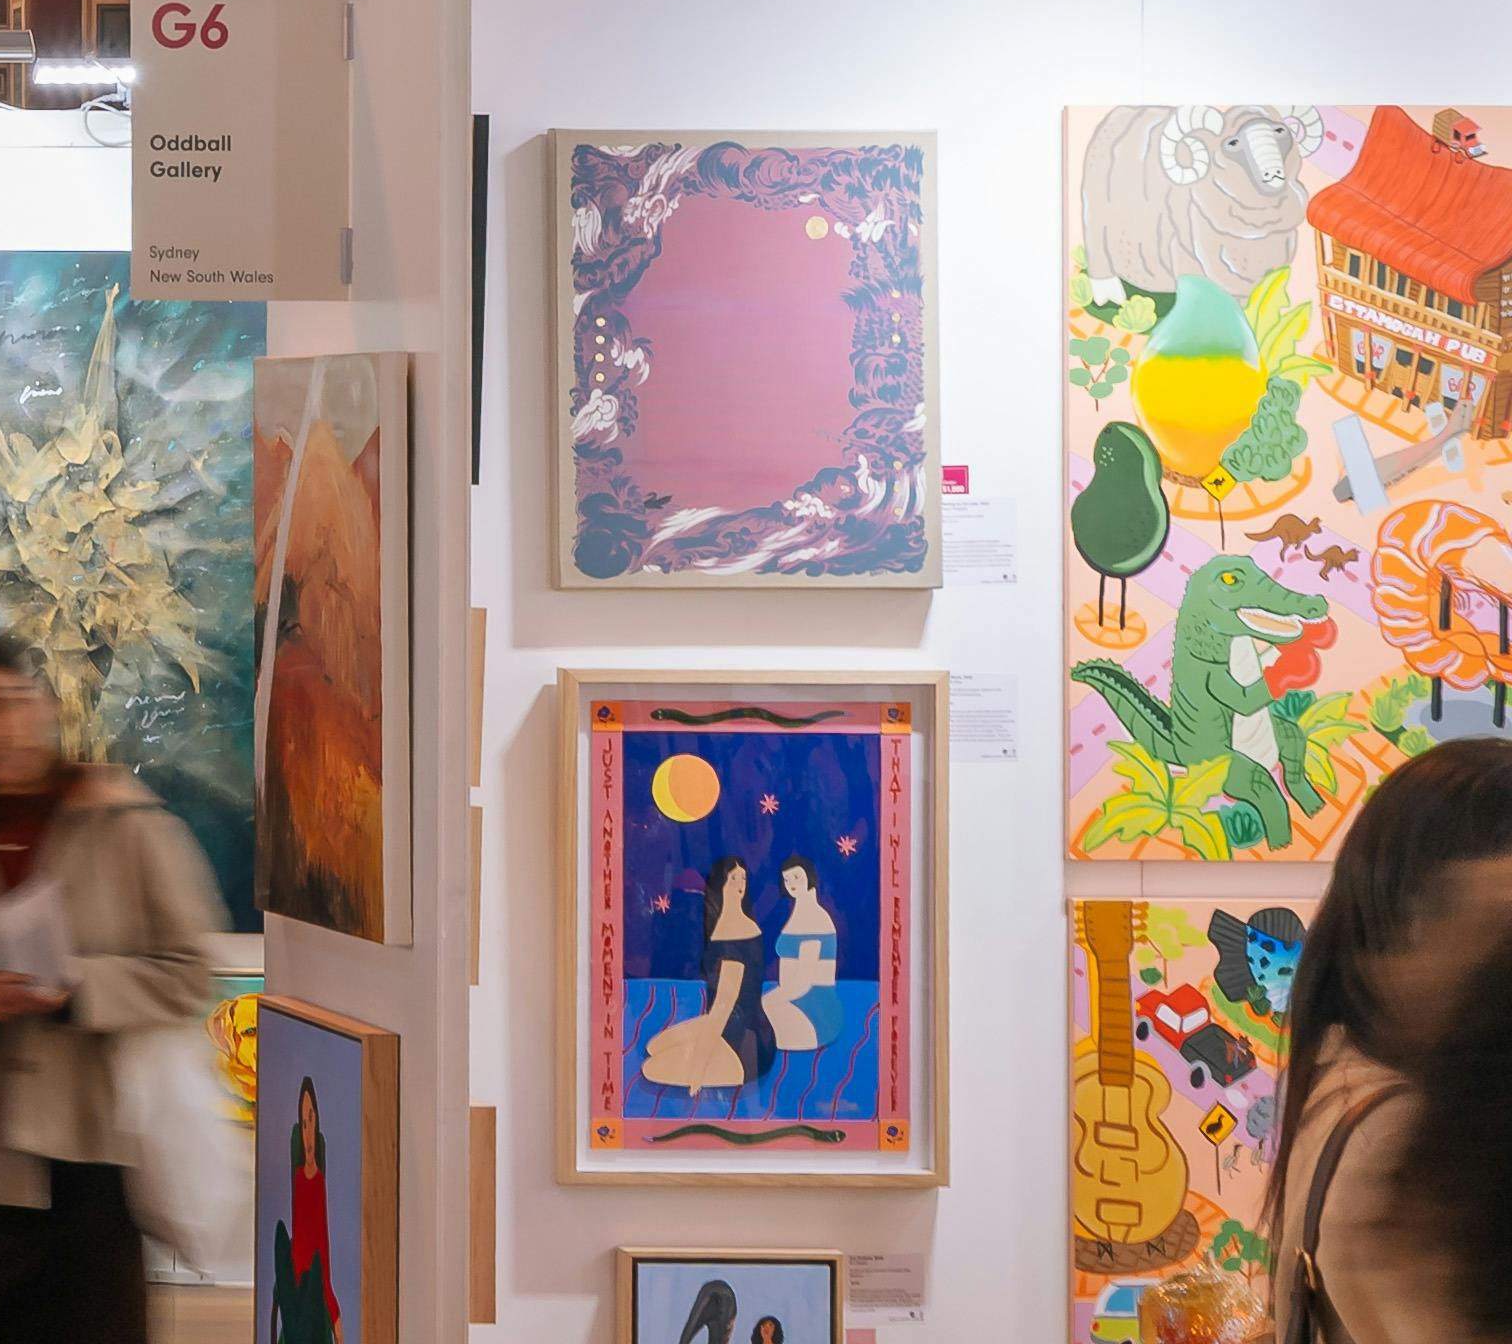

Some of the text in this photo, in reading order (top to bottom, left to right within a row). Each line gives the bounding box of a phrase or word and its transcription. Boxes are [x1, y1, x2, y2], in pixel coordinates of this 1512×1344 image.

[152, 2, 229, 50] G6
[150, 134, 232, 152] Oddball
[150, 160, 222, 182] Gallery
[149, 245, 200, 262] Sydney
[150, 270, 274, 284] New South Wales
[1445, 338, 1488, 364] PUB
[602, 738, 613, 800] JUST
[889, 739, 901, 804] THAT
[601, 922, 614, 1005] MOMENT
[603, 1013, 614, 1039] IN
[601, 1052, 614, 1111] TIME
